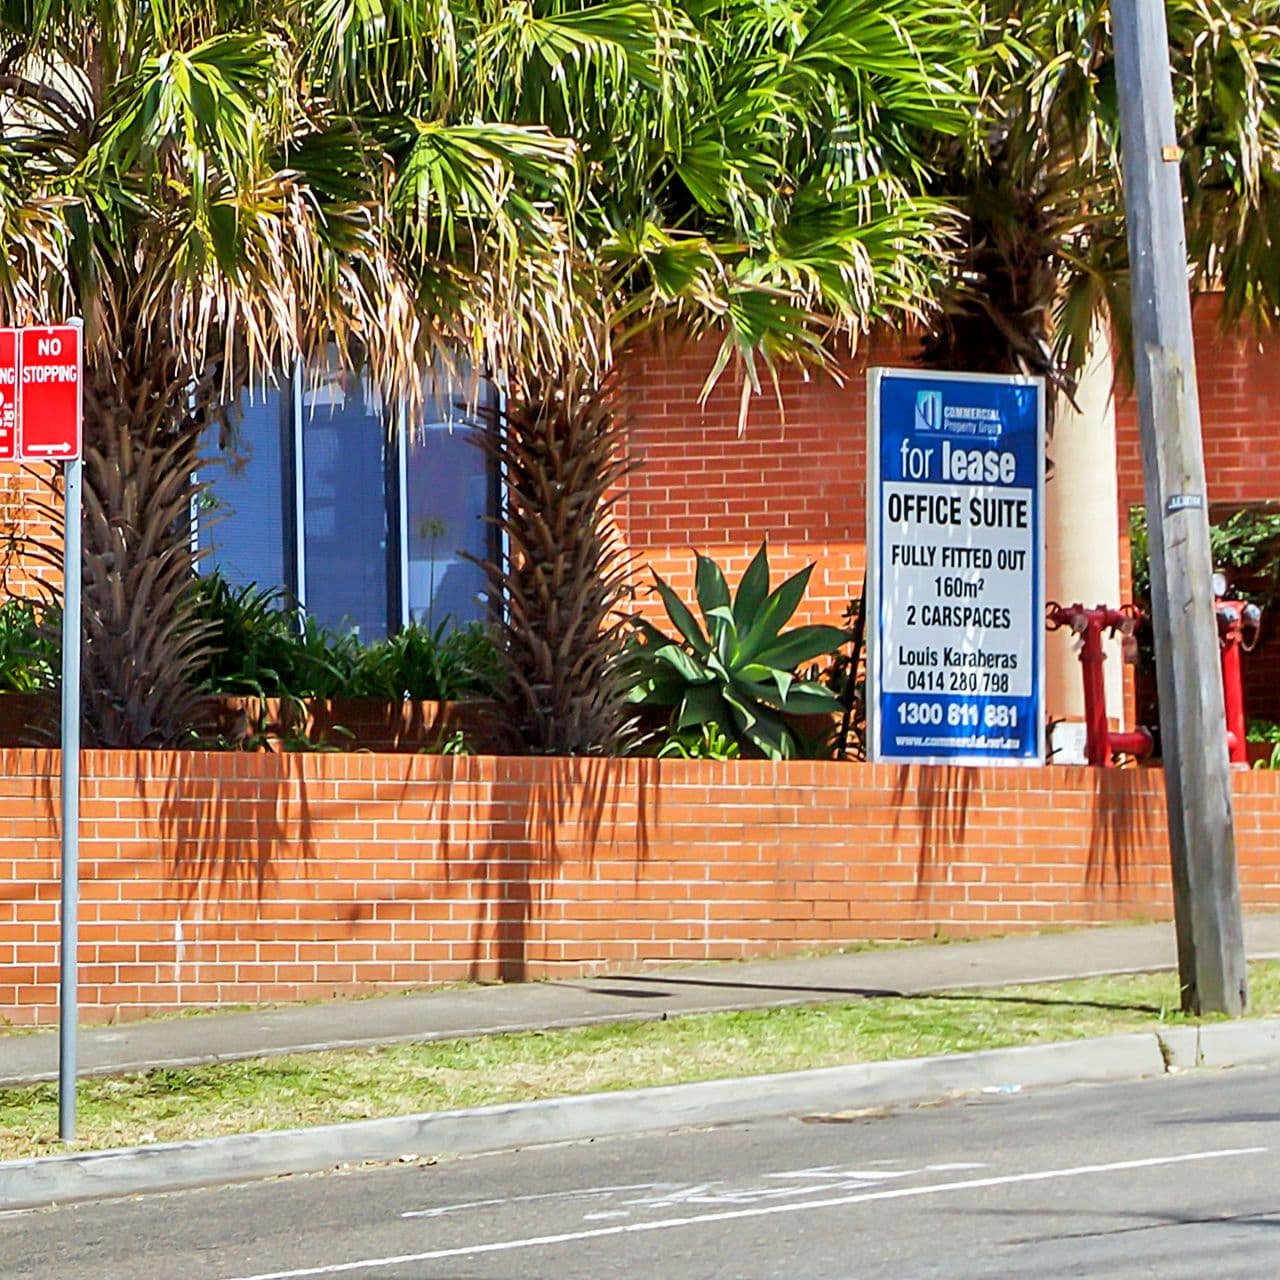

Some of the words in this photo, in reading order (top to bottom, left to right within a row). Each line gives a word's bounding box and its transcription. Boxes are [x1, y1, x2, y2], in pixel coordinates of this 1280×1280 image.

[38, 338, 62, 356] NO
[23, 365, 77, 383] STOPPING
[944, 406, 1000, 420] COMMERCIAL
[900, 438, 934, 479] for
[942, 440, 1016, 484] lease
[888, 493, 961, 525] OFFICE
[969, 497, 1027, 528] SUITE
[891, 545, 936, 567] FULLY
[942, 547, 992, 569] FITTED
[997, 549, 1026, 570] OUT
[906, 605, 916, 626] 2
[921, 605, 1011, 629] CARSPACES
[899, 646, 938, 666] Louis
[907, 670, 944, 691] 0414
[949, 671, 977, 692] 280
[983, 673, 1009, 693] 798
[897, 701, 943, 725] 1300
[947, 702, 979, 727] 811
[984, 704, 1018, 728] 881
